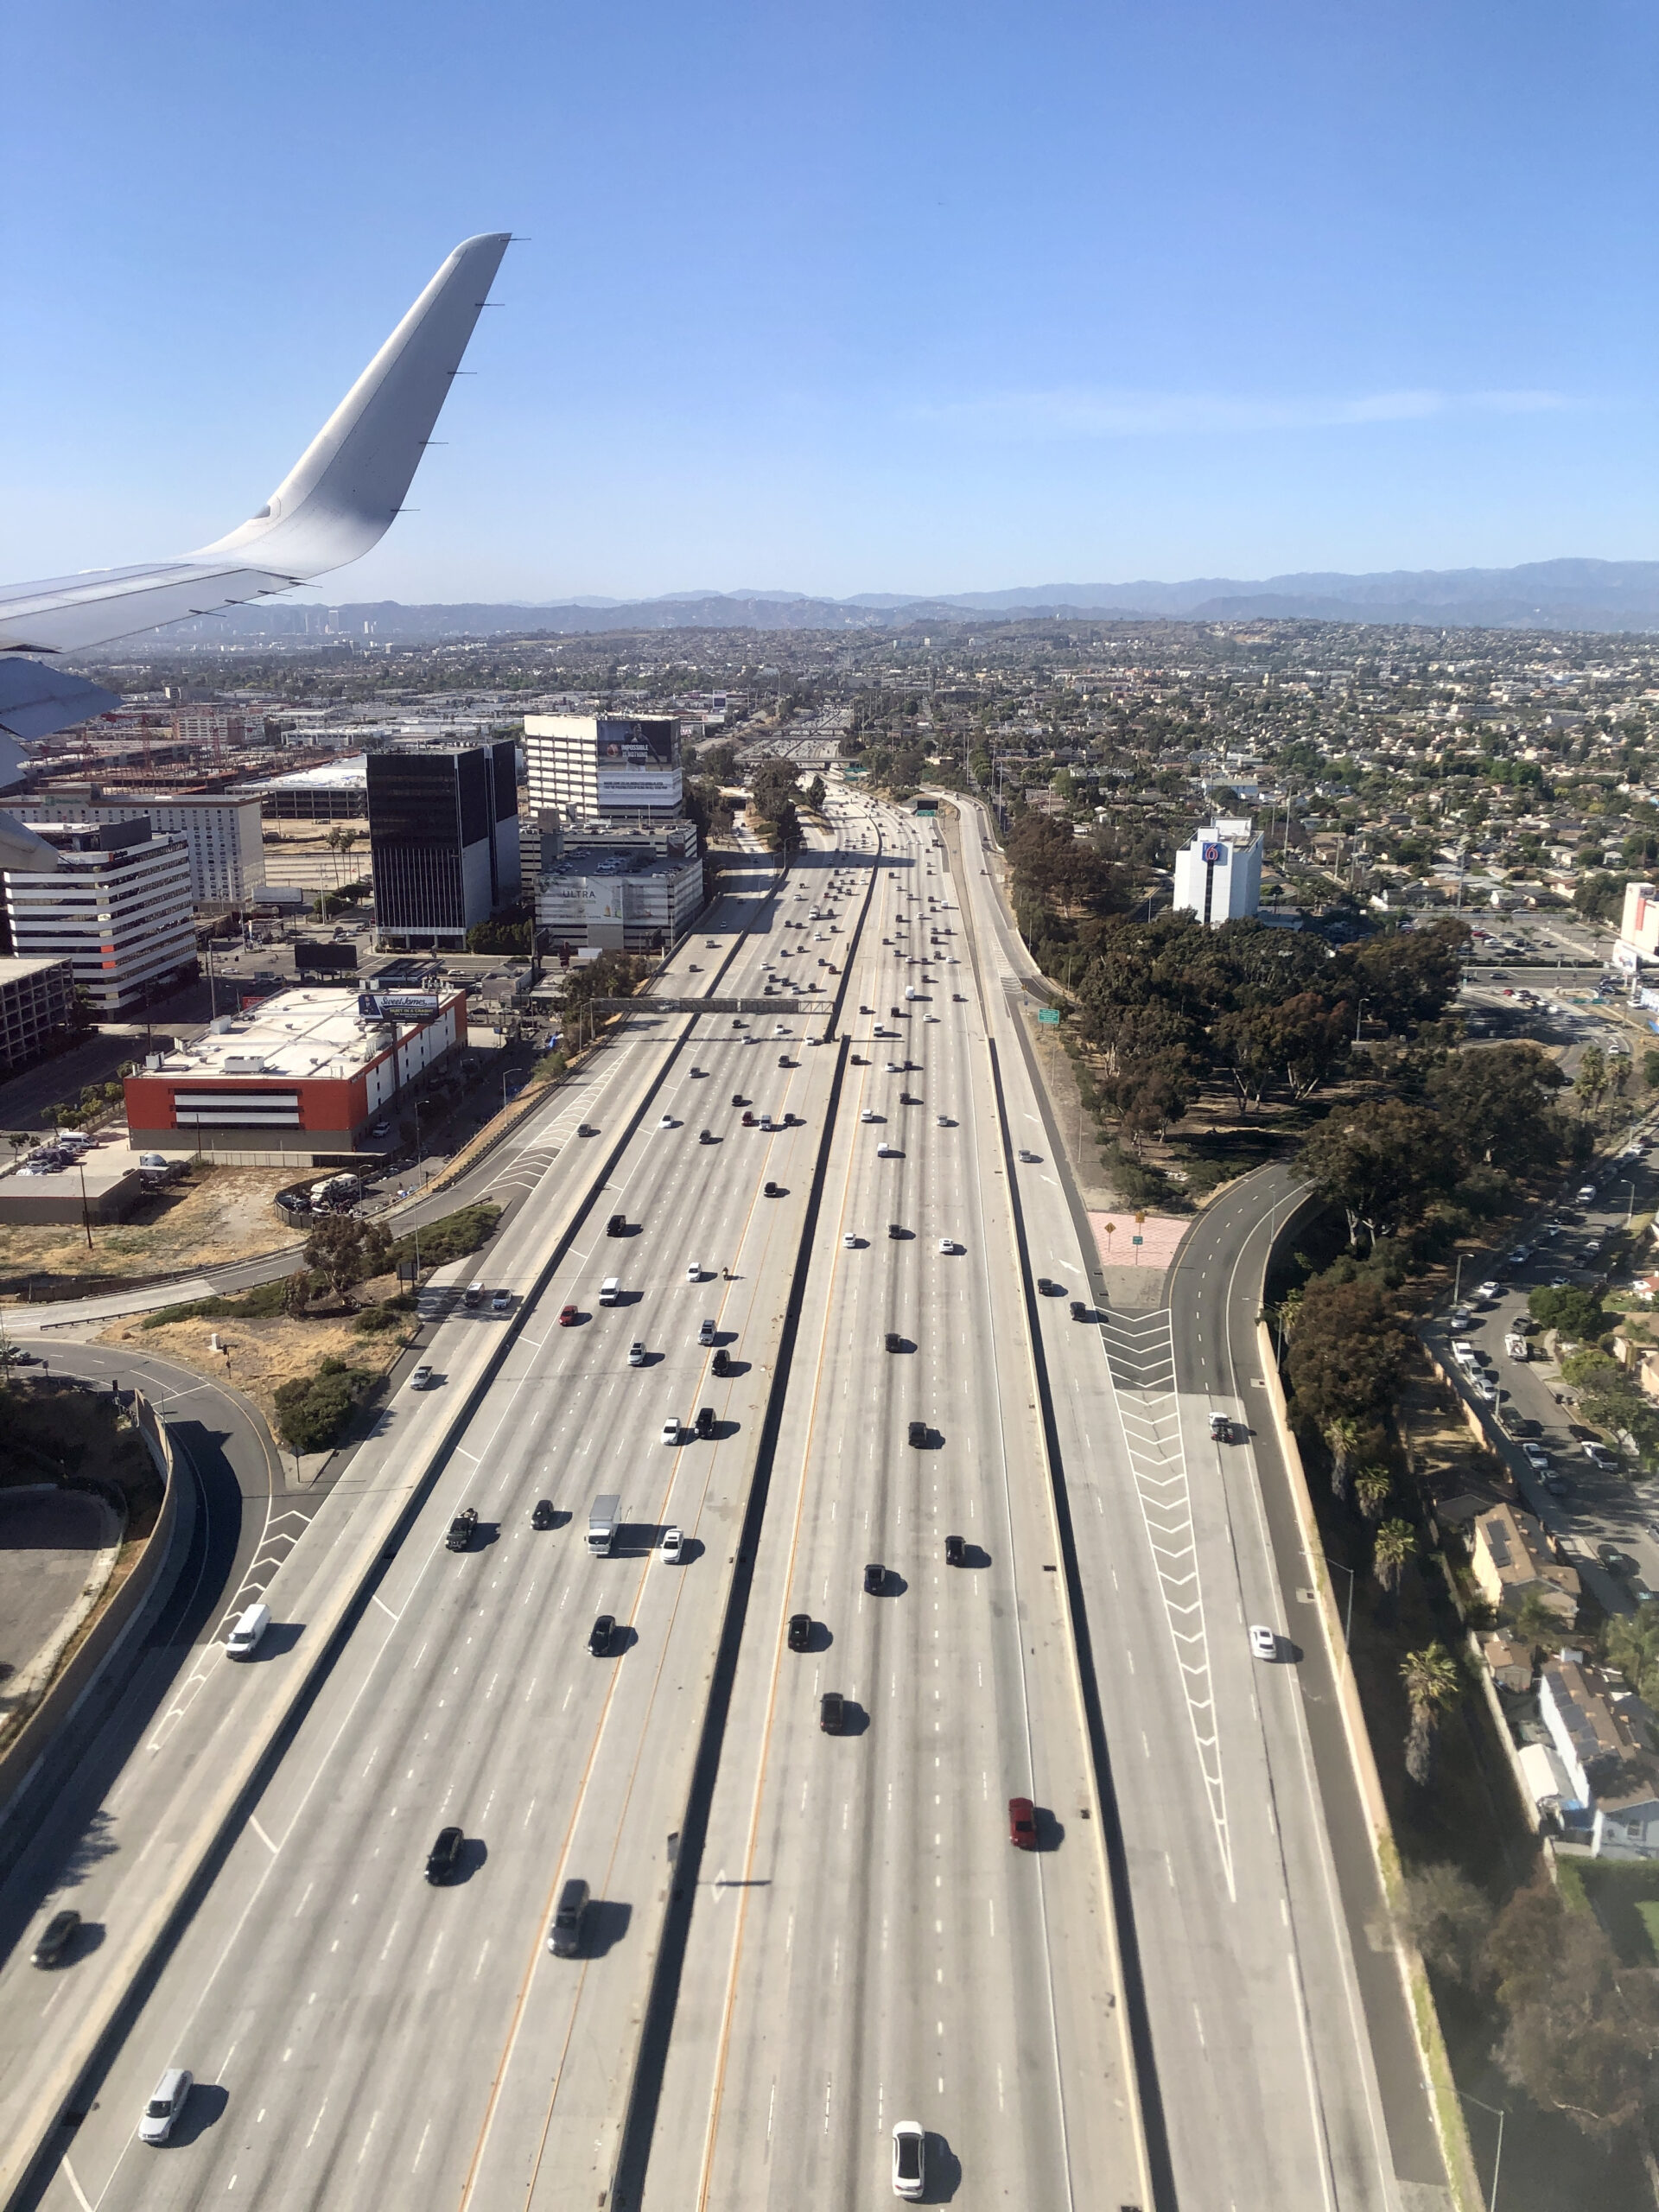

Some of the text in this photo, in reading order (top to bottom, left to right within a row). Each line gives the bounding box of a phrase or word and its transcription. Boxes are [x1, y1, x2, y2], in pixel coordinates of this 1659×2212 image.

[1205, 843, 1218, 861] 6
[563, 890, 596, 899] ULTRA
[381, 996, 402, 1006] Sweet
